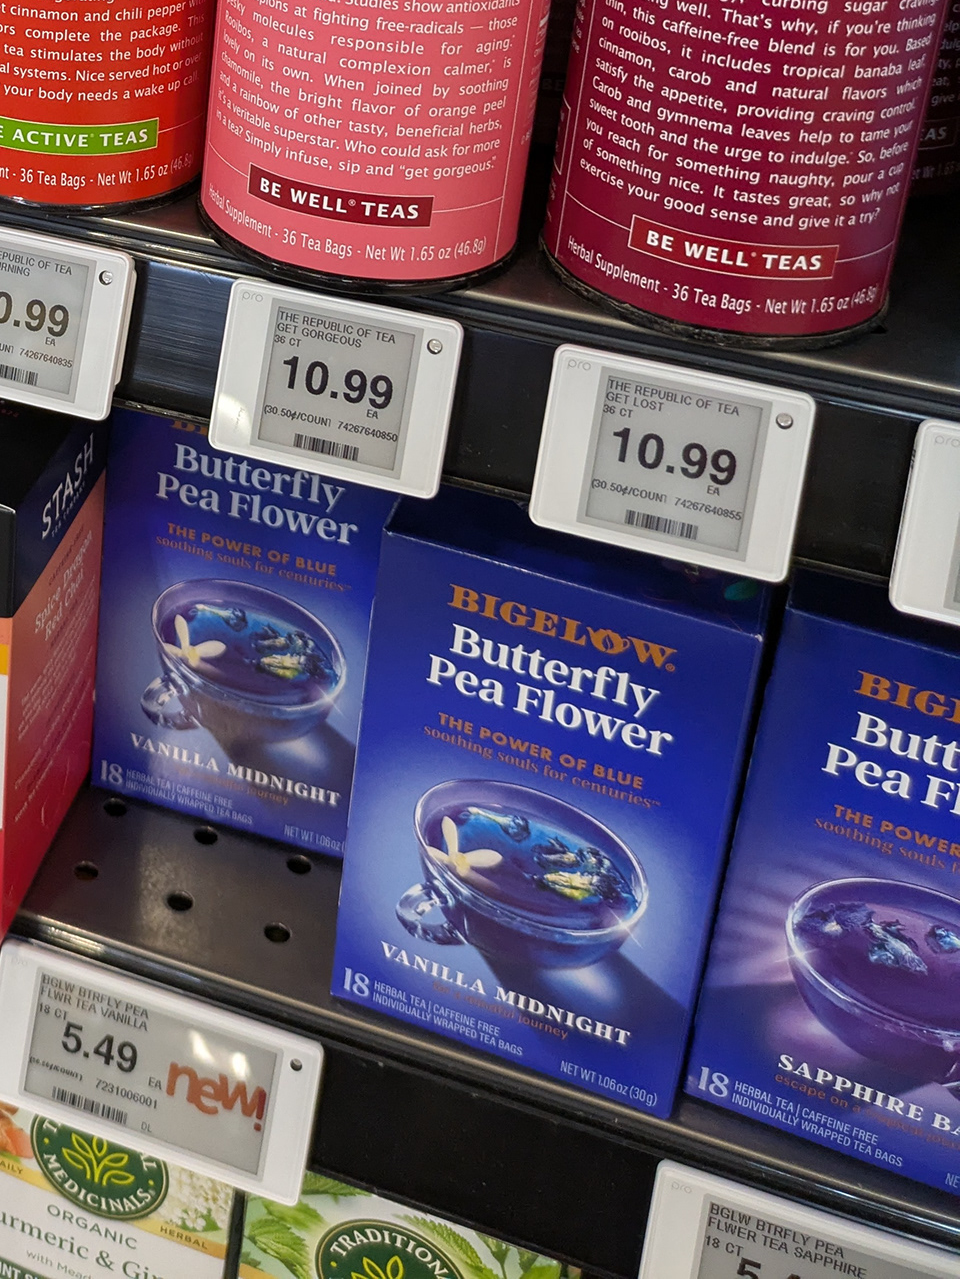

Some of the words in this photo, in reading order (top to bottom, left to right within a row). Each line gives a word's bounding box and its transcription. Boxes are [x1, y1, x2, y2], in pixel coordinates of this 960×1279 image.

[100, 128, 148, 146] TEAS
[647, 230, 673, 251] BE
[762, 254, 822, 270] TEAS
[283, 355, 393, 409] 10.99
[606, 392, 628, 405] GET
[633, 398, 664, 412] LOST
[613, 426, 736, 486] 10.99
[450, 623, 661, 719] Butterfly
[426, 654, 504, 707] Pea
[513, 682, 674, 757] Flower
[438, 712, 474, 735] THE
[479, 725, 552, 762] POWER
[559, 754, 587, 772] OF
[593, 762, 644, 790] BLUE
[343, 967, 370, 998] 18
[380, 941, 487, 995] VANILLA
[496, 986, 631, 1046] MIDNIGHT
[62, 1022, 138, 1073] 5.49
[778, 1054, 924, 1121] SAPPHIRE
[710, 1201, 751, 1225] BGLW
[756, 1218, 811, 1246] BTRFLY
[815, 1239, 844, 1257] PEA
